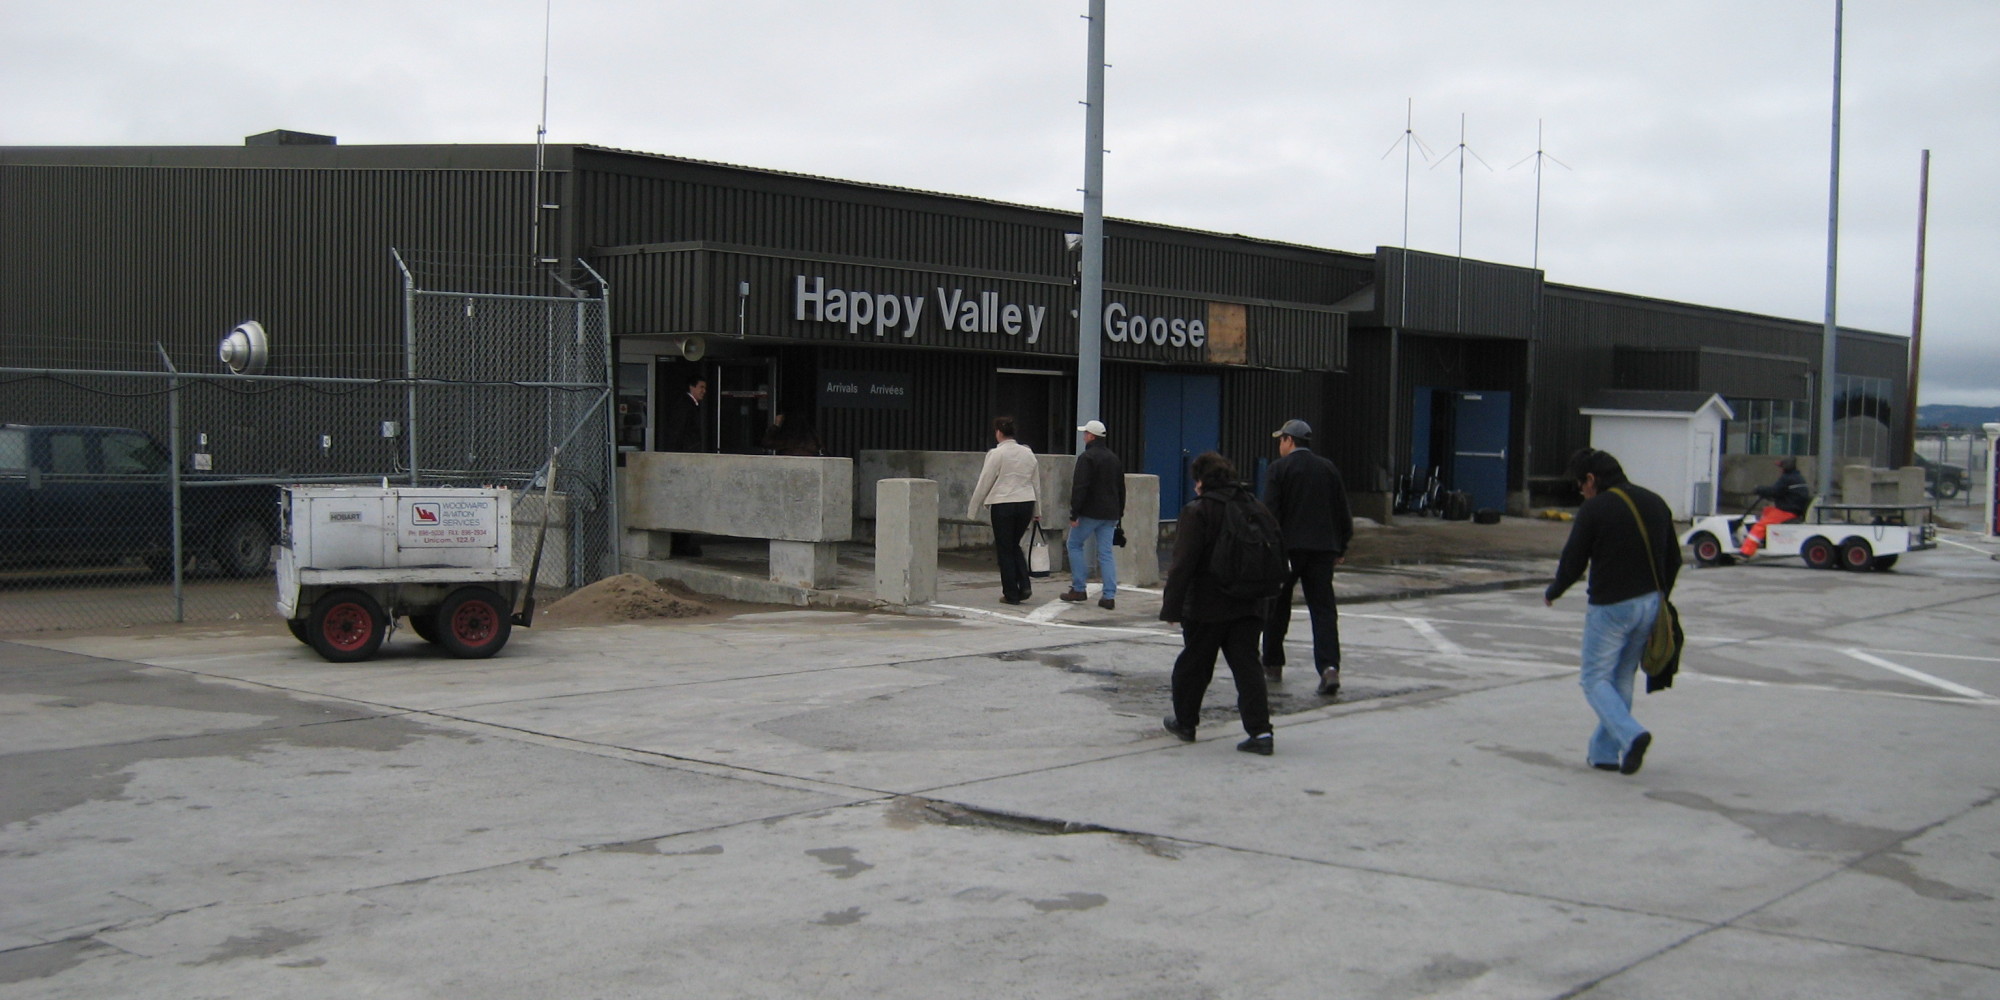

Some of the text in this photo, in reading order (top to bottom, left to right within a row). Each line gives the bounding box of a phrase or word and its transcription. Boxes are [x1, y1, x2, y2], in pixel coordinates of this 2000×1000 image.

[795, 275, 1205, 348] Happy Valley Goose
[826, 382, 904, 395] Arrivals Arrivées
[330, 513, 361, 521] HOBART
